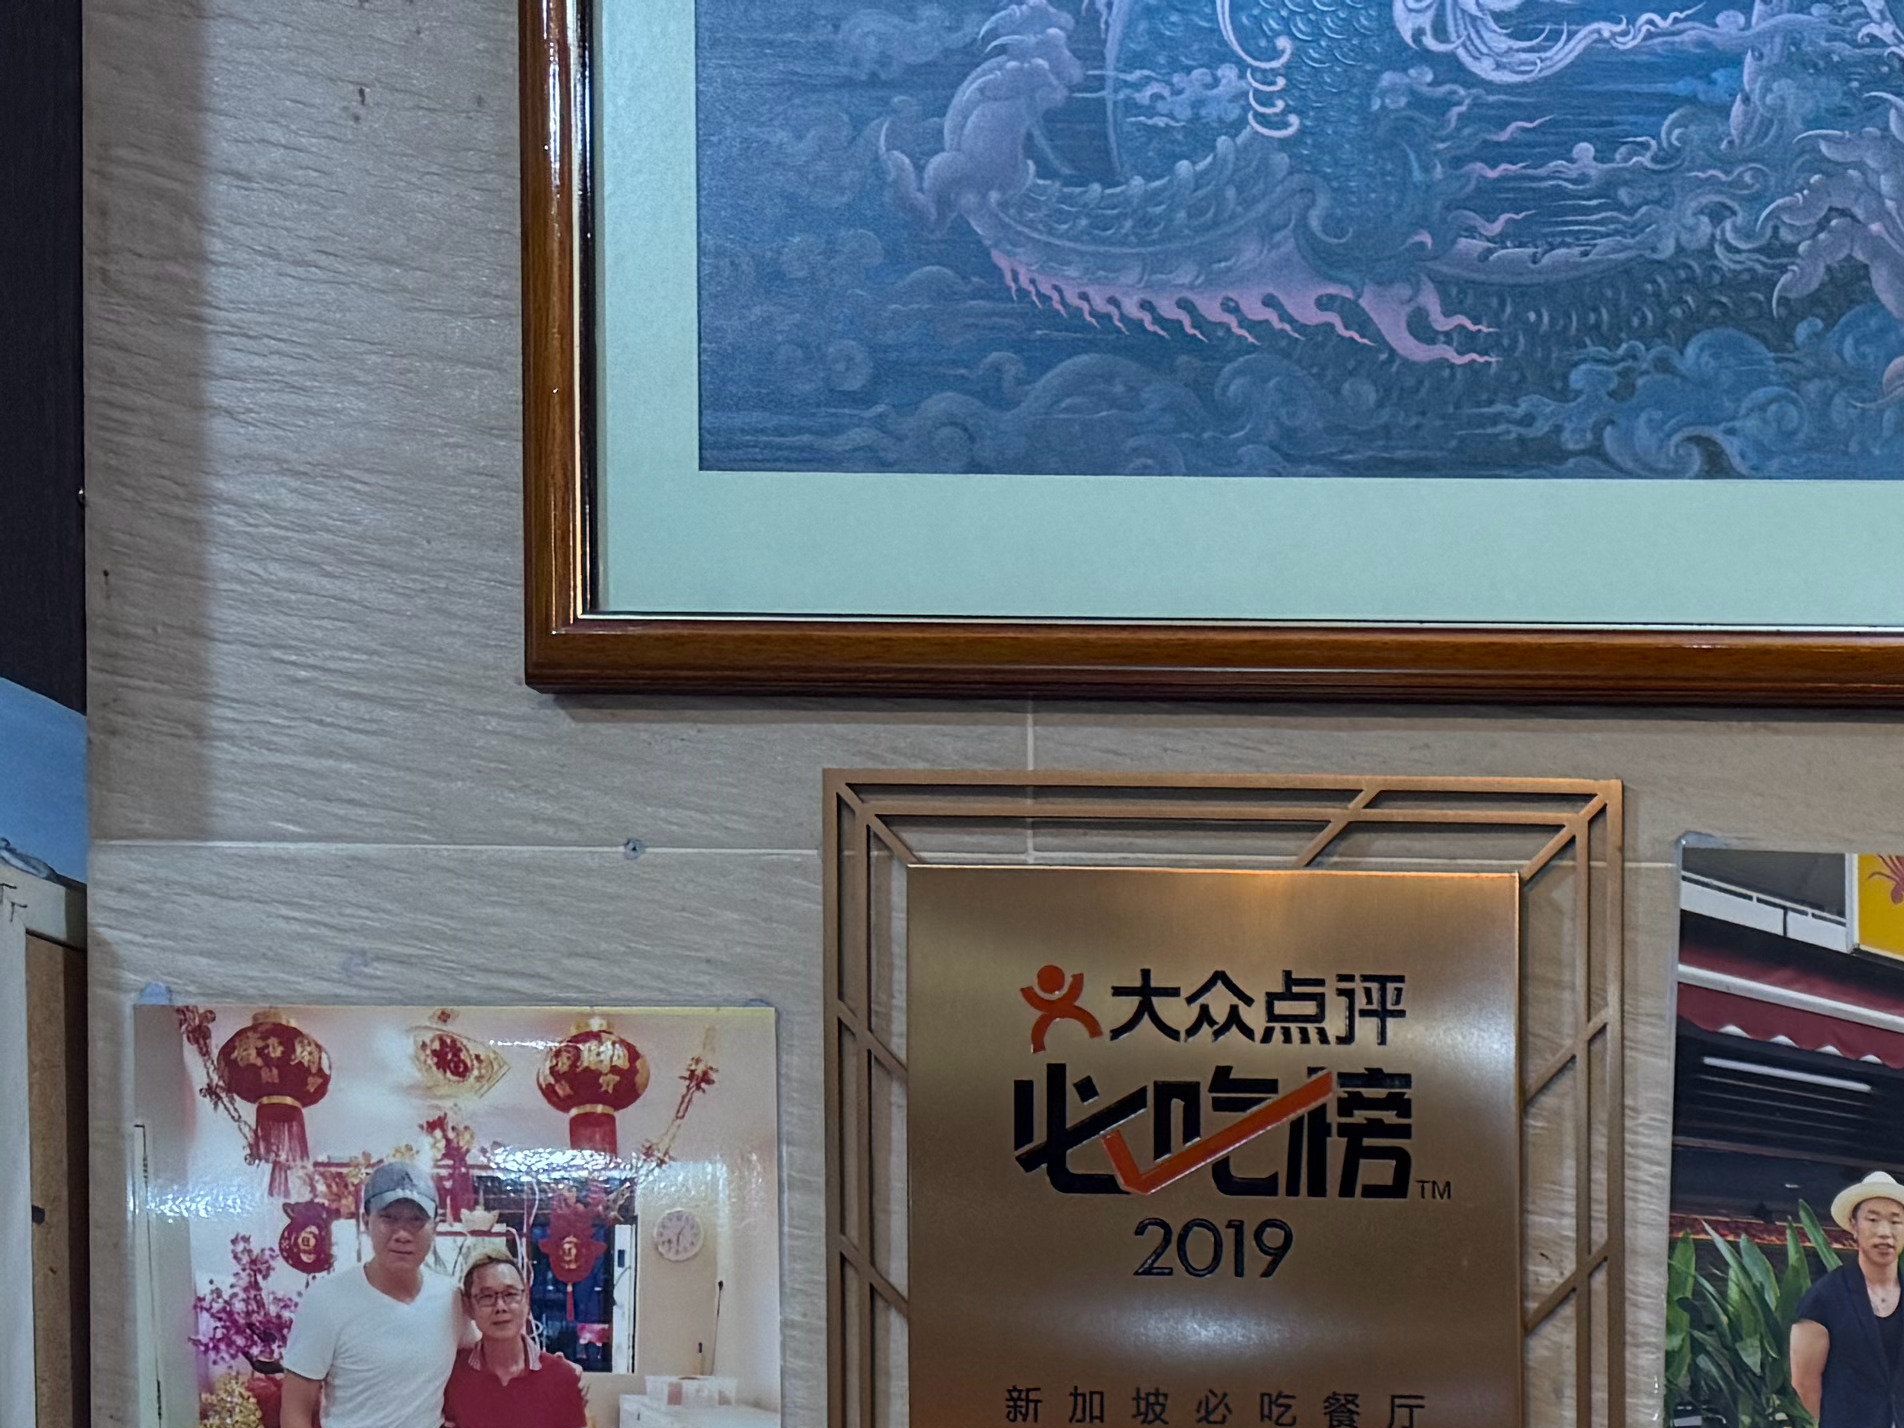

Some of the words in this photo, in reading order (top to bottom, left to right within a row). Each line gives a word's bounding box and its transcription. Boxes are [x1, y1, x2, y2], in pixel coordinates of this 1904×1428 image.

[1111, 968, 1407, 1046] 大众点评
[1013, 1062, 1413, 1200] 必吃榜
[1416, 1178, 1452, 1201] TM
[1133, 1216, 1294, 1279] 2019
